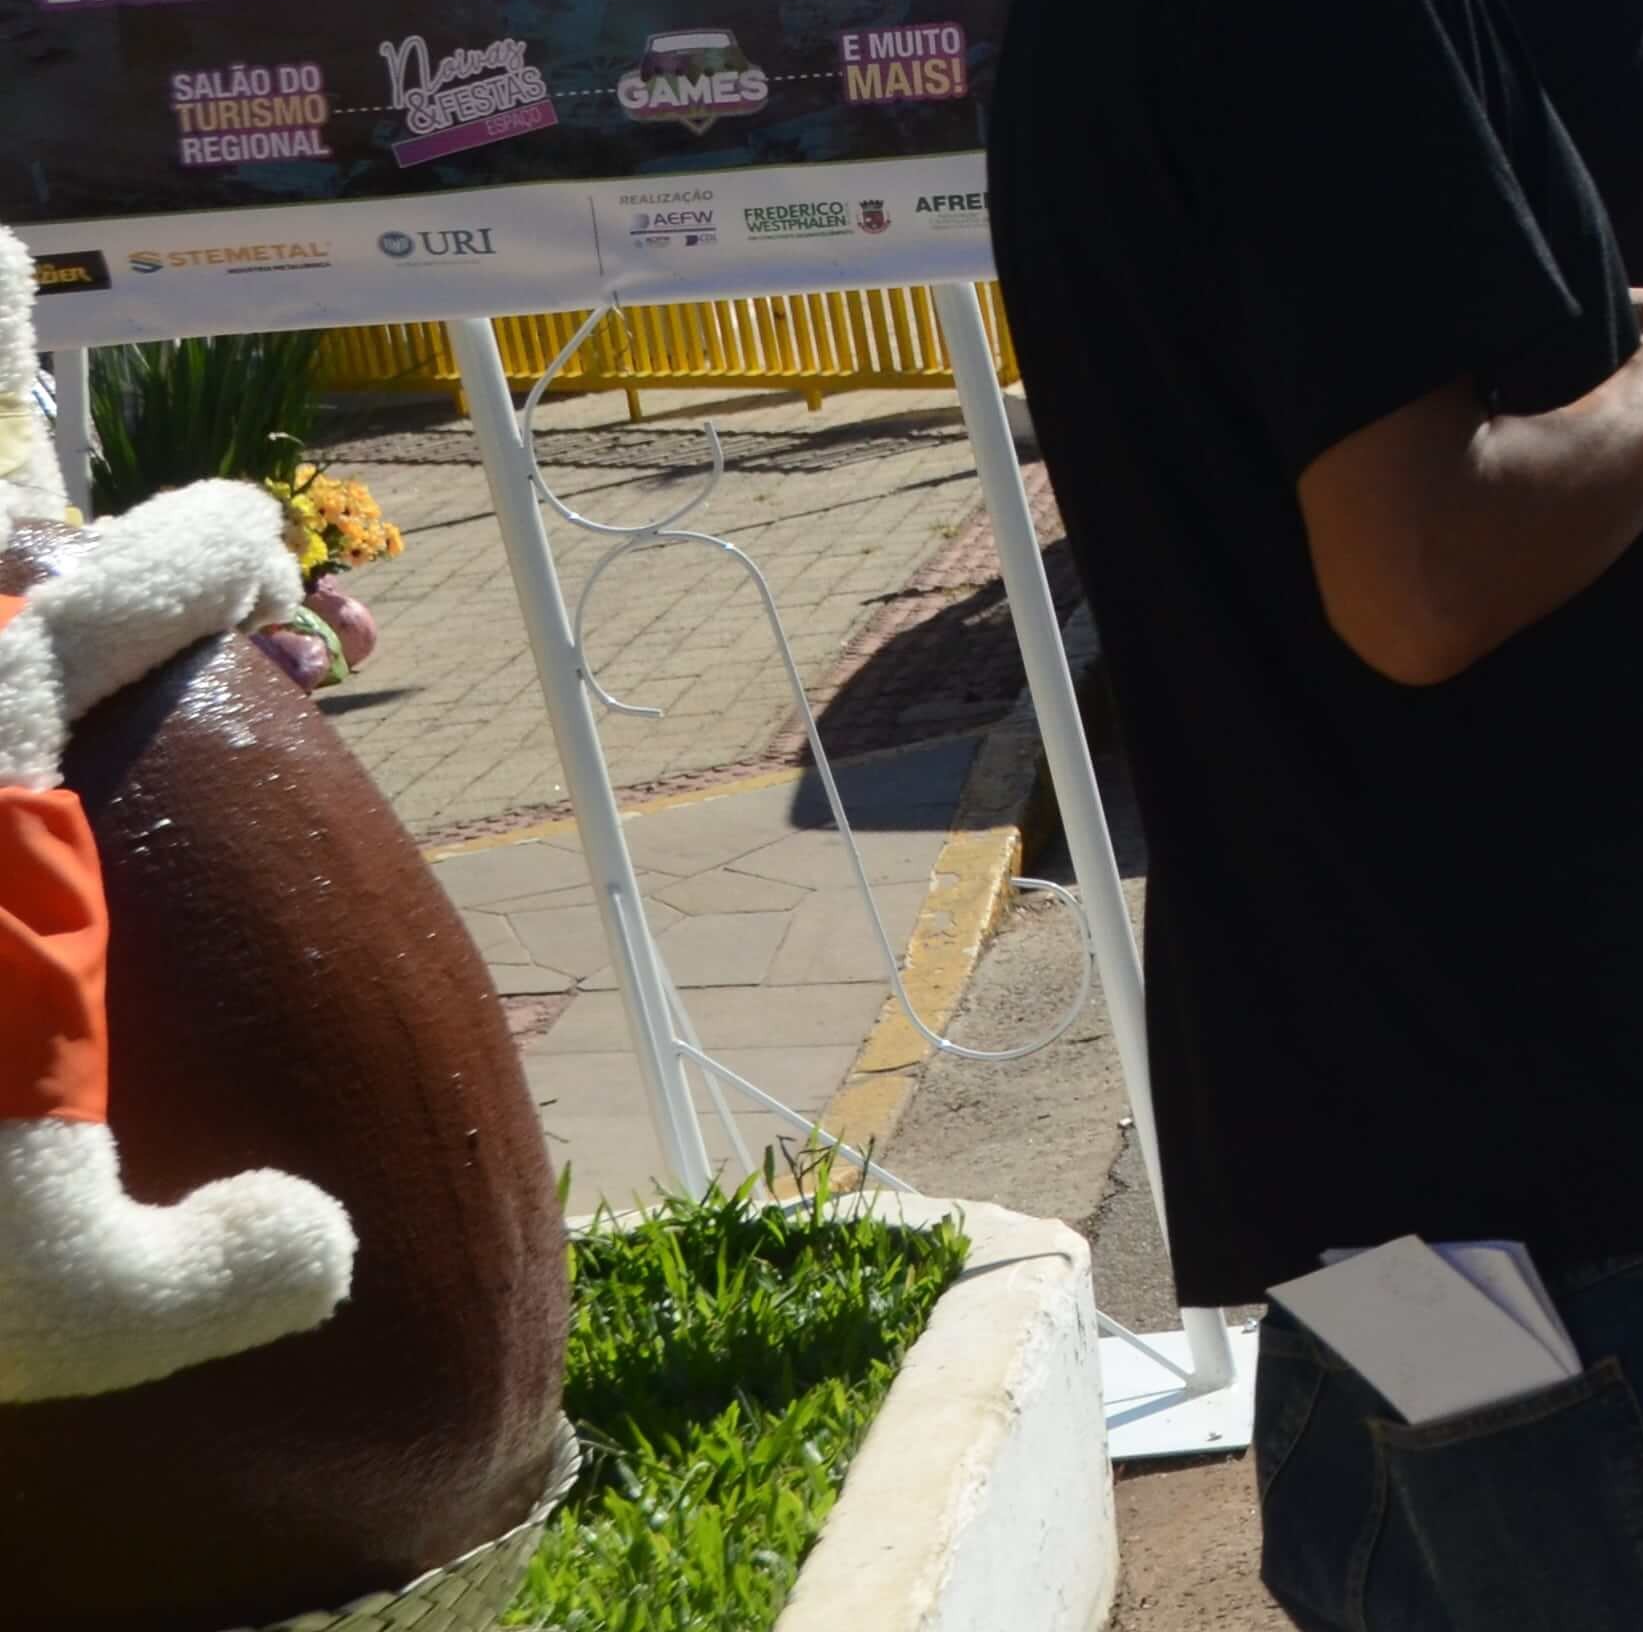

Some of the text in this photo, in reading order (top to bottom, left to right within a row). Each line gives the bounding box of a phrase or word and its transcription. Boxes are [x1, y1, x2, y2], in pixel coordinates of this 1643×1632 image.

[843, 26, 961, 61] E MUITO
[172, 64, 322, 102] SALÃO DO
[615, 68, 769, 110] GAMES
[847, 56, 968, 102] MAIS!
[176, 94, 327, 134] TURISMO
[181, 129, 330, 165] REGIONAL
[744, 201, 845, 222] FREDERICO
[746, 214, 848, 233] WESTPHALEN
[168, 242, 329, 267] STEMETAL
[420, 228, 497, 256] URI
